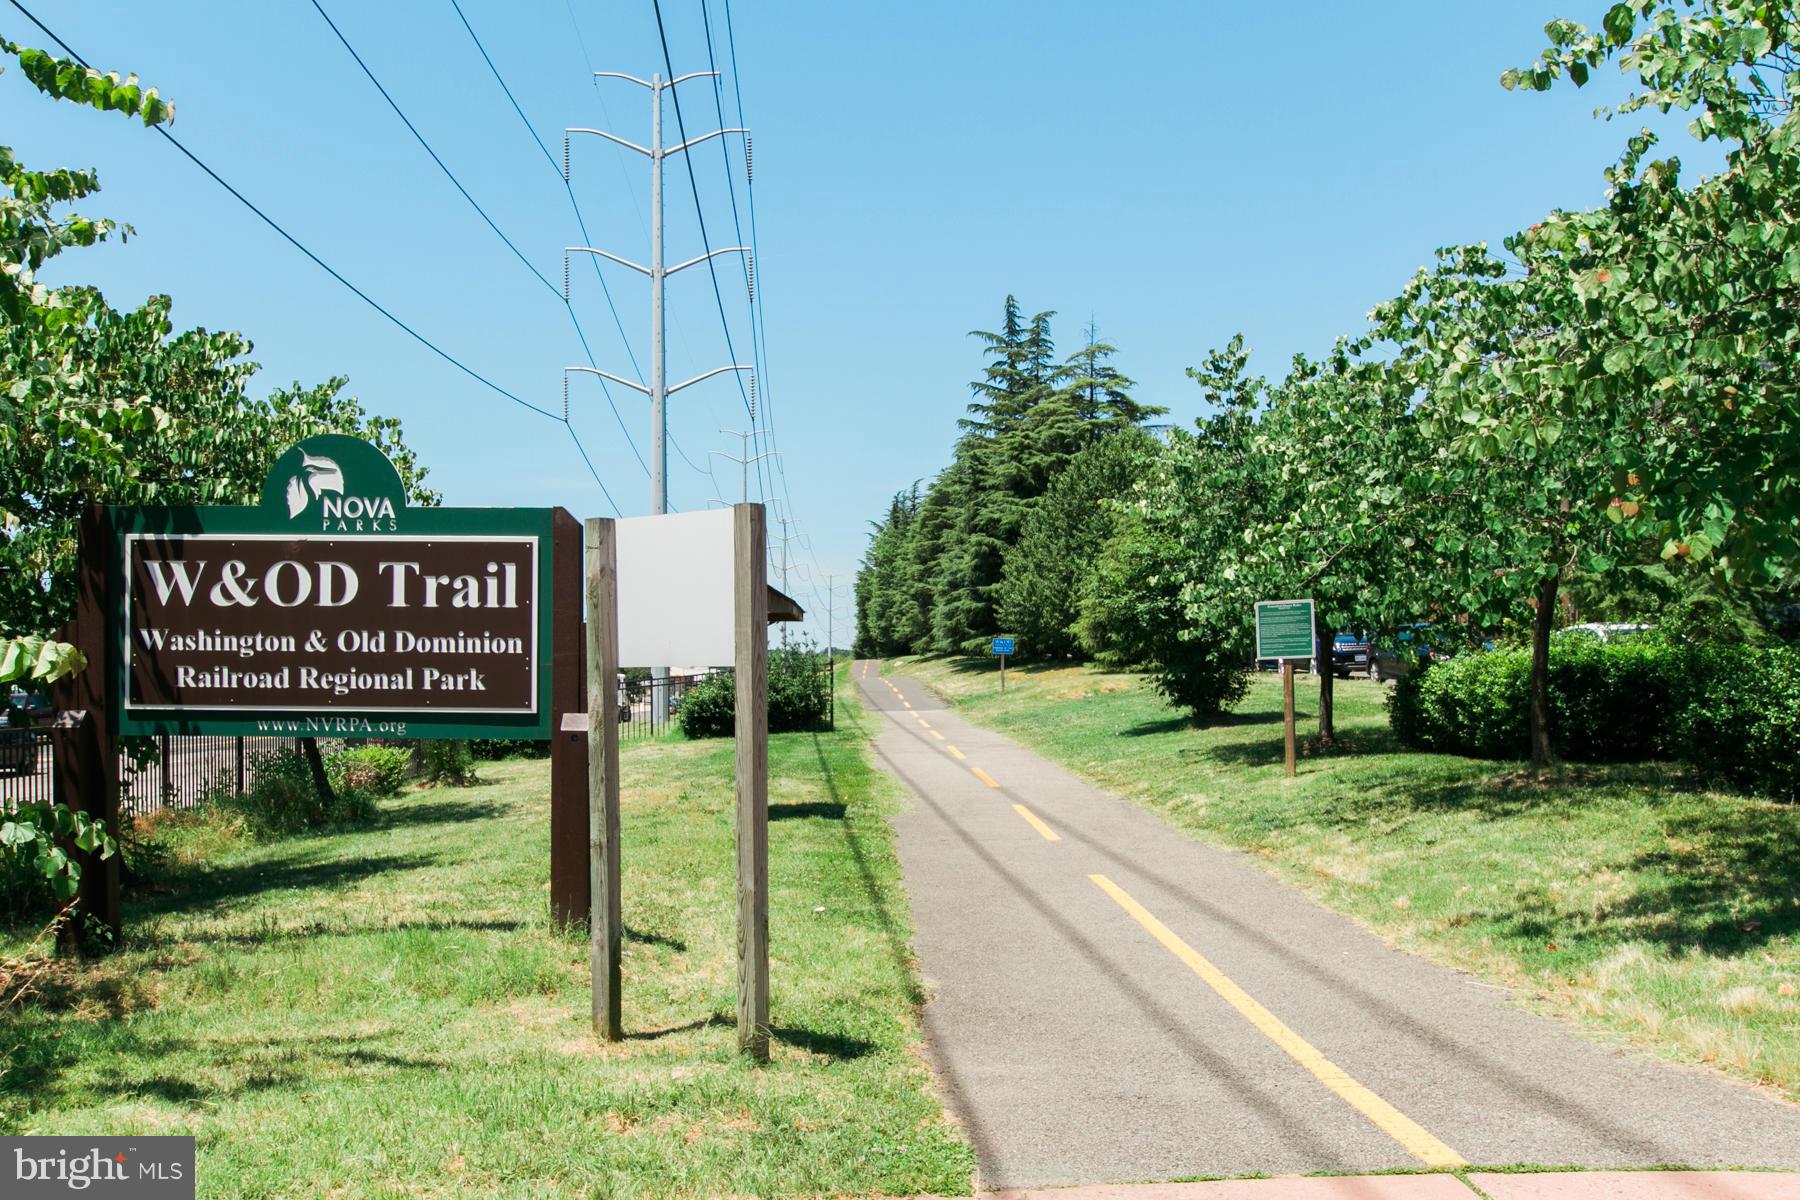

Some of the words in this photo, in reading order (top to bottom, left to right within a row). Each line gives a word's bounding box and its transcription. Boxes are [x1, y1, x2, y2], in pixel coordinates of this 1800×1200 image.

[323, 496, 396, 519] NOVA
[323, 519, 397, 532] PARKS
[144, 559, 359, 607] W&OD
[378, 561, 519, 609] Trail
[139, 628, 296, 658] Washington
[304, 630, 328, 654] &
[337, 630, 385, 655] Old
[395, 630, 523, 655] Dominion
[176, 665, 289, 690] Railroad
[299, 666, 413, 696] Regional
[423, 668, 486, 692] Park
[256, 717, 407, 735] www.NVRPA.org
